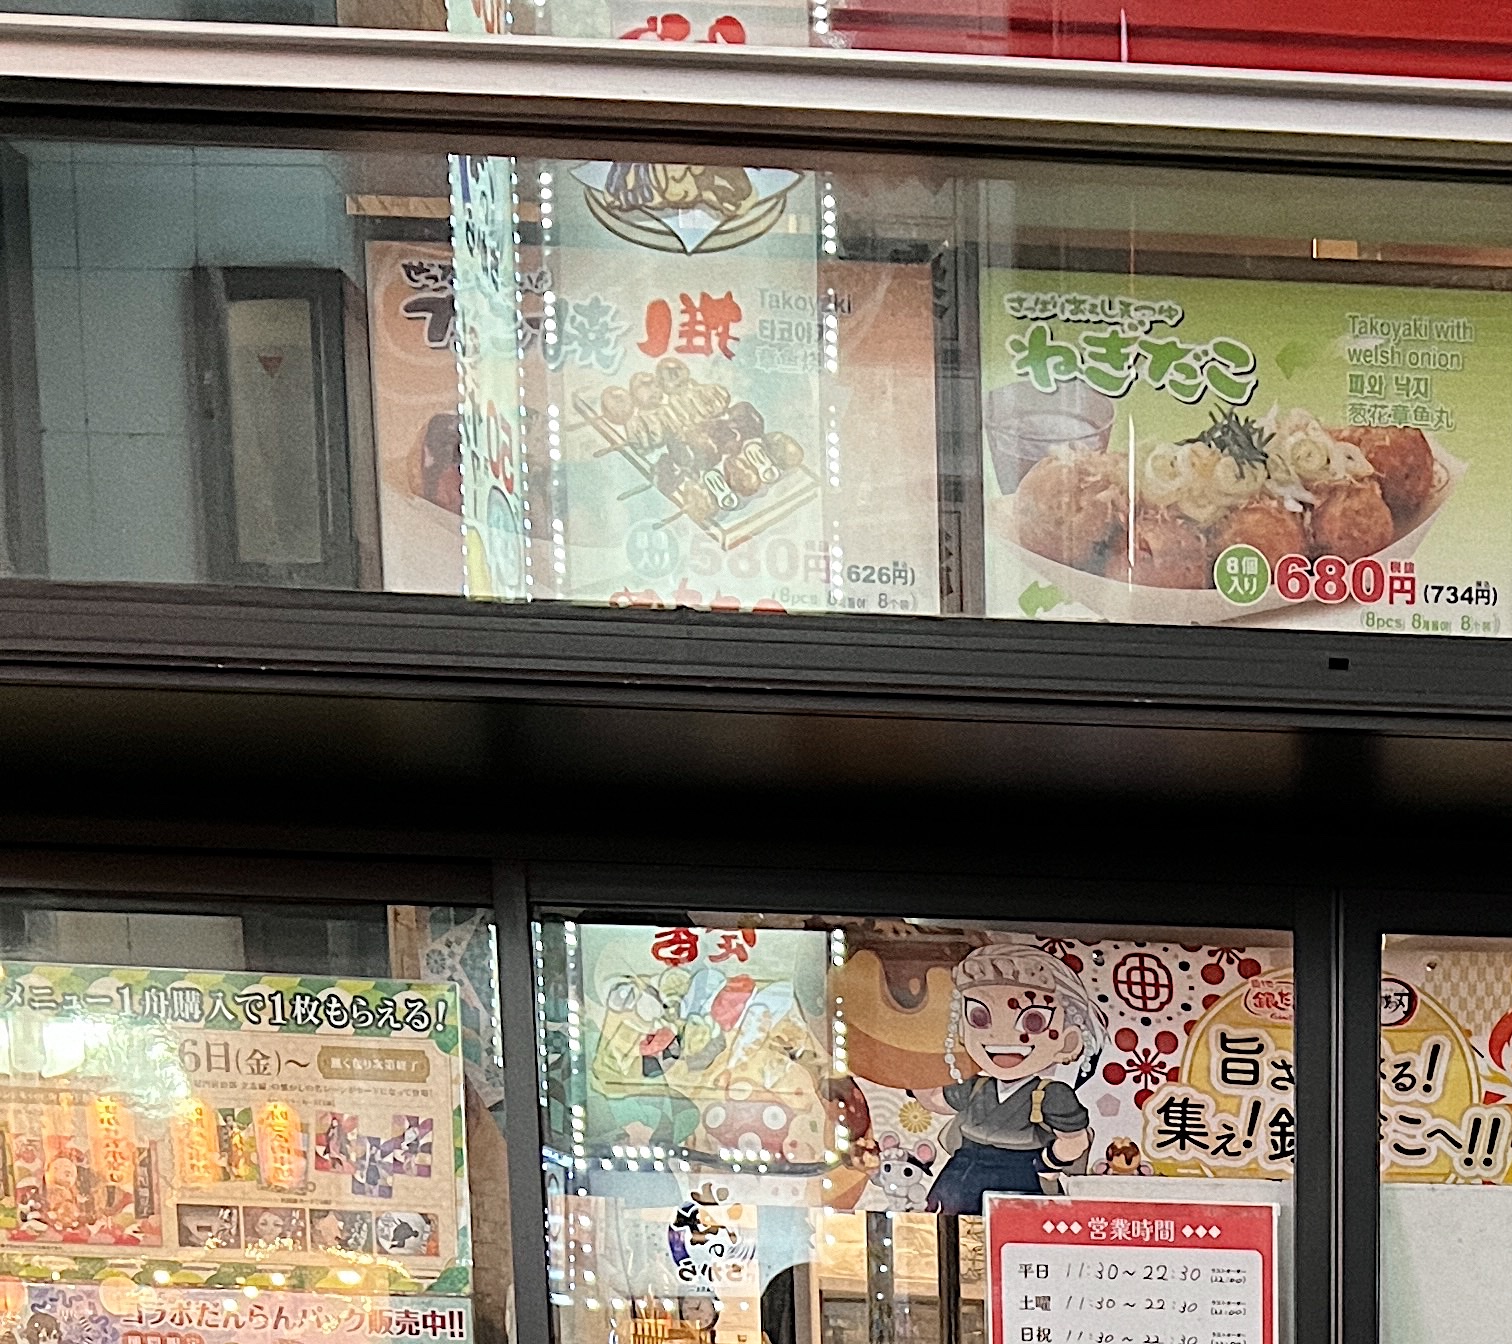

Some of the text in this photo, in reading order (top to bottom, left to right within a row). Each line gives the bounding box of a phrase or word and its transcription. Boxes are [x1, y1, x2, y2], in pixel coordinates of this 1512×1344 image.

[1348, 314, 1474, 342] Takoyaki with
[1008, 321, 1256, 403] ねぎだこ
[1348, 345, 1463, 369] welsh onion
[1087, 1217, 1176, 1242] 営業時間
[1018, 1263, 1050, 1280] 平日
[1019, 1295, 1051, 1312] 土曜
[1021, 1326, 1052, 1343] 日祝
